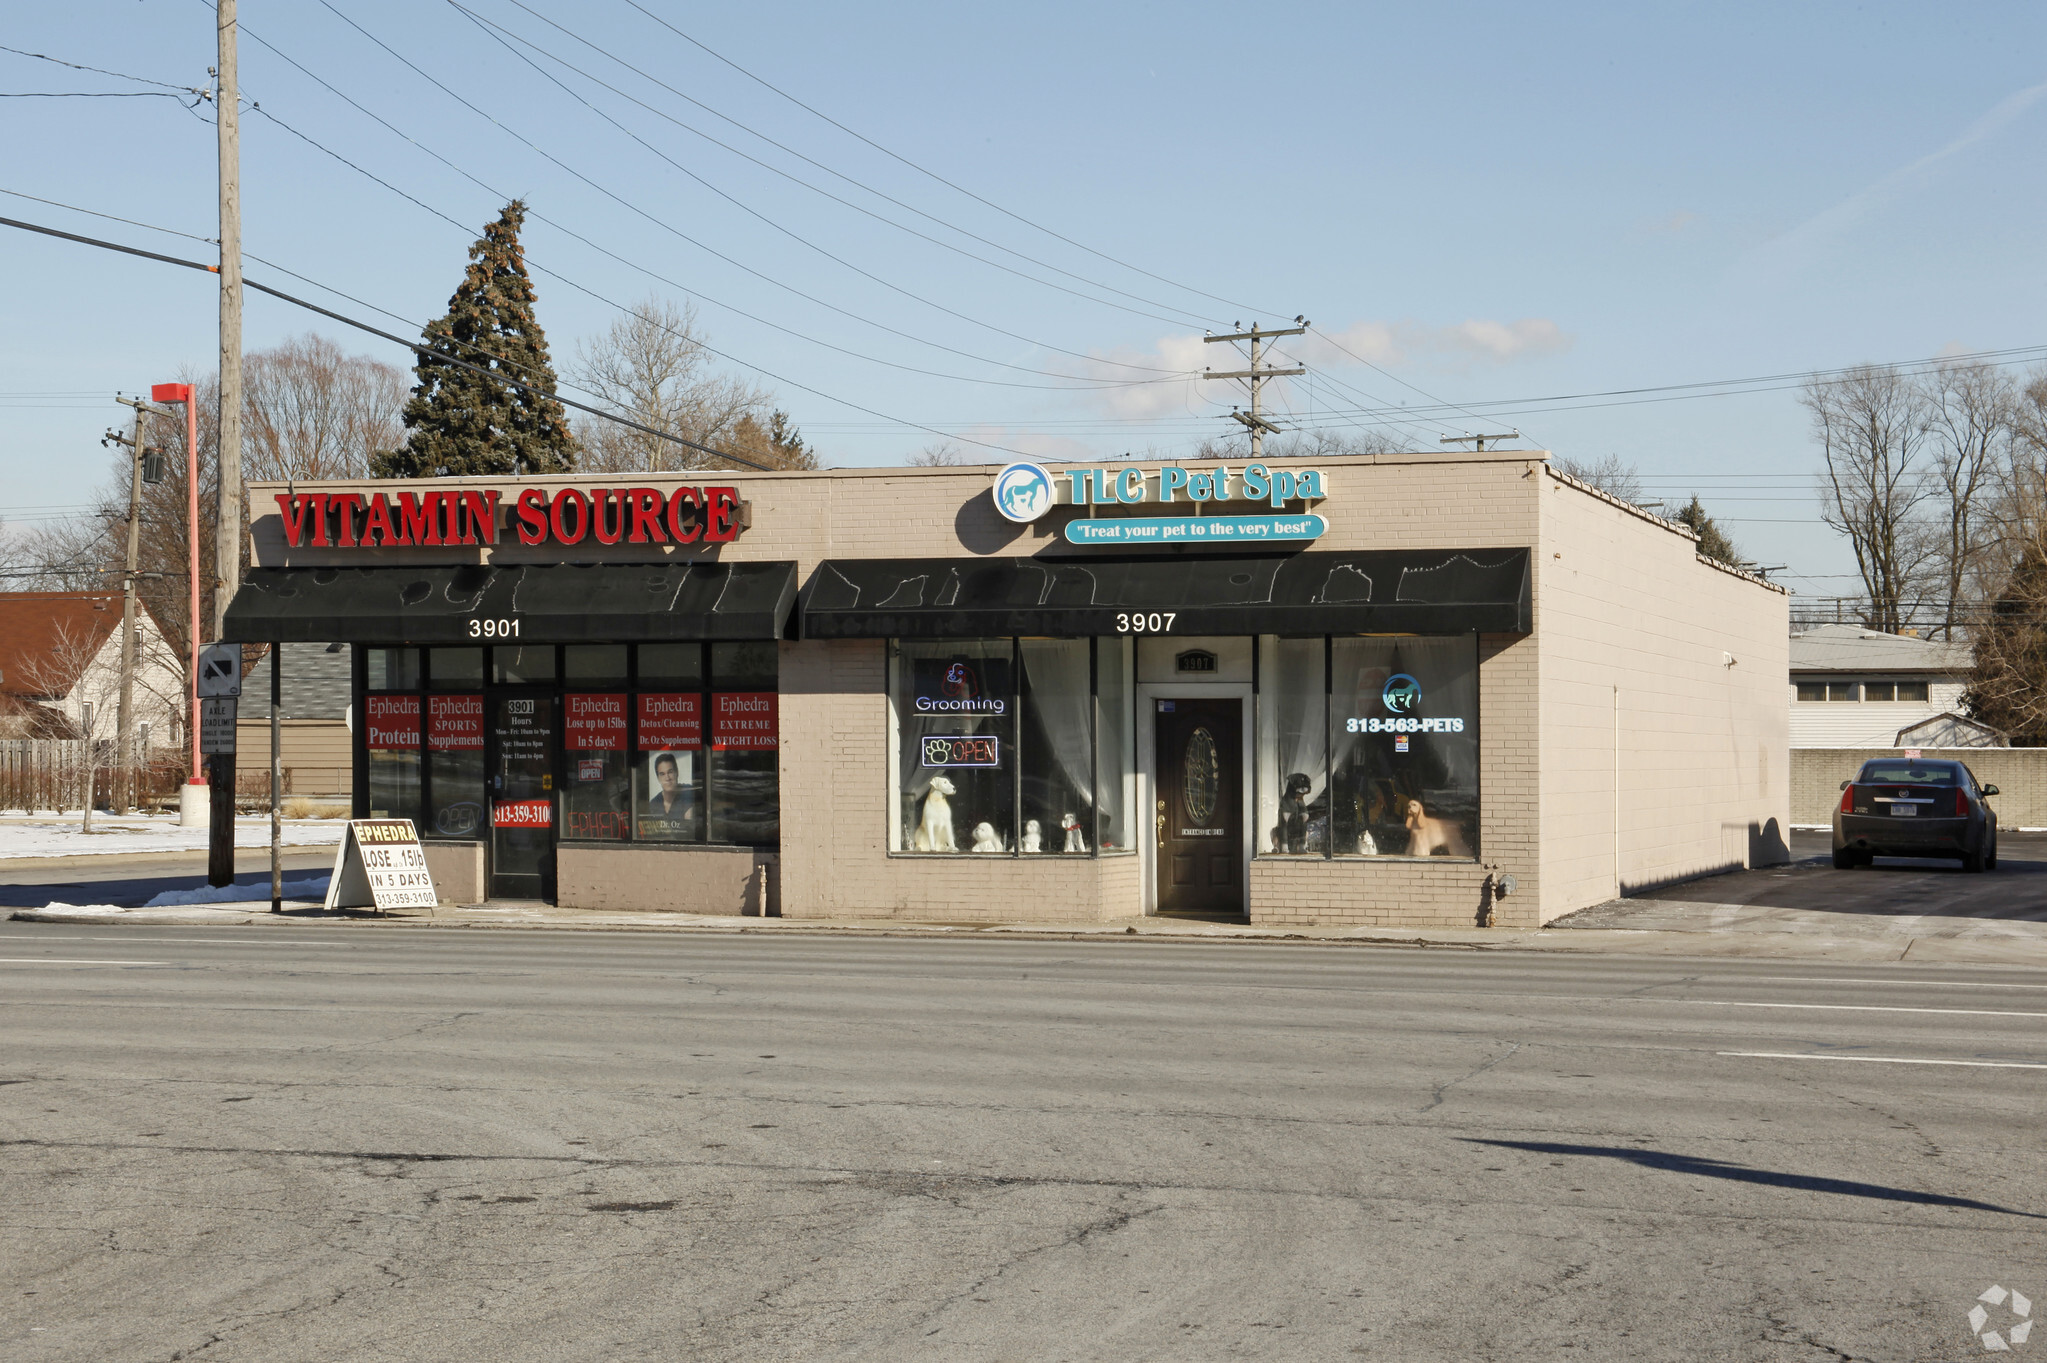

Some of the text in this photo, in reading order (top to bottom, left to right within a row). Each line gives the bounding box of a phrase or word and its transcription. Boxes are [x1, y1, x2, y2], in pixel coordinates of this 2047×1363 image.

[1064, 463, 1326, 508] TLC Pet Spa
[274, 486, 741, 547] VITAMIN SOURCE
[1077, 521, 1312, 539] "Treat your pet to the very best"
[469, 619, 519, 637] 3901
[1116, 613, 1176, 632] 3907
[1184, 657, 1208, 669] 3907
[209, 706, 226, 715] AXLE
[368, 697, 420, 719] Ephedra
[430, 697, 483, 719] Ephedra
[509, 701, 534, 713] 3901
[572, 697, 620, 717] Ephedra
[646, 697, 694, 716] Ephedra
[720, 696, 770, 715] Ephedra
[916, 695, 1004, 714] Grooming
[202, 718, 234, 727] LOAD LIMIT
[435, 720, 478, 731] SPORTS
[511, 716, 532, 725] Hours
[566, 717, 627, 732] Lose up to 15lbs
[640, 719, 700, 730] Detox/Cleansing
[720, 720, 771, 730] EXTREME
[1346, 718, 1464, 733] 313-563-PETS
[369, 727, 420, 745] Protein
[428, 733, 484, 749] Supplements
[577, 736, 616, 749] In 5 days!
[640, 736, 701, 747] Dr. Oz Supplements
[714, 735, 777, 746] WEIGHT LOSS
[953, 741, 995, 762] OPEN
[581, 768, 601, 779] OPEN
[438, 808, 481, 829] OPEN
[660, 820, 671, 828] Dr.
[671, 820, 681, 829] Oz
[356, 826, 418, 842] EPHEDRA
[363, 849, 392, 868] LOSE
[402, 849, 424, 867] 15lb
[370, 873, 429, 887] IN 5 DAYS
[376, 892, 434, 905] 313-359-3100
